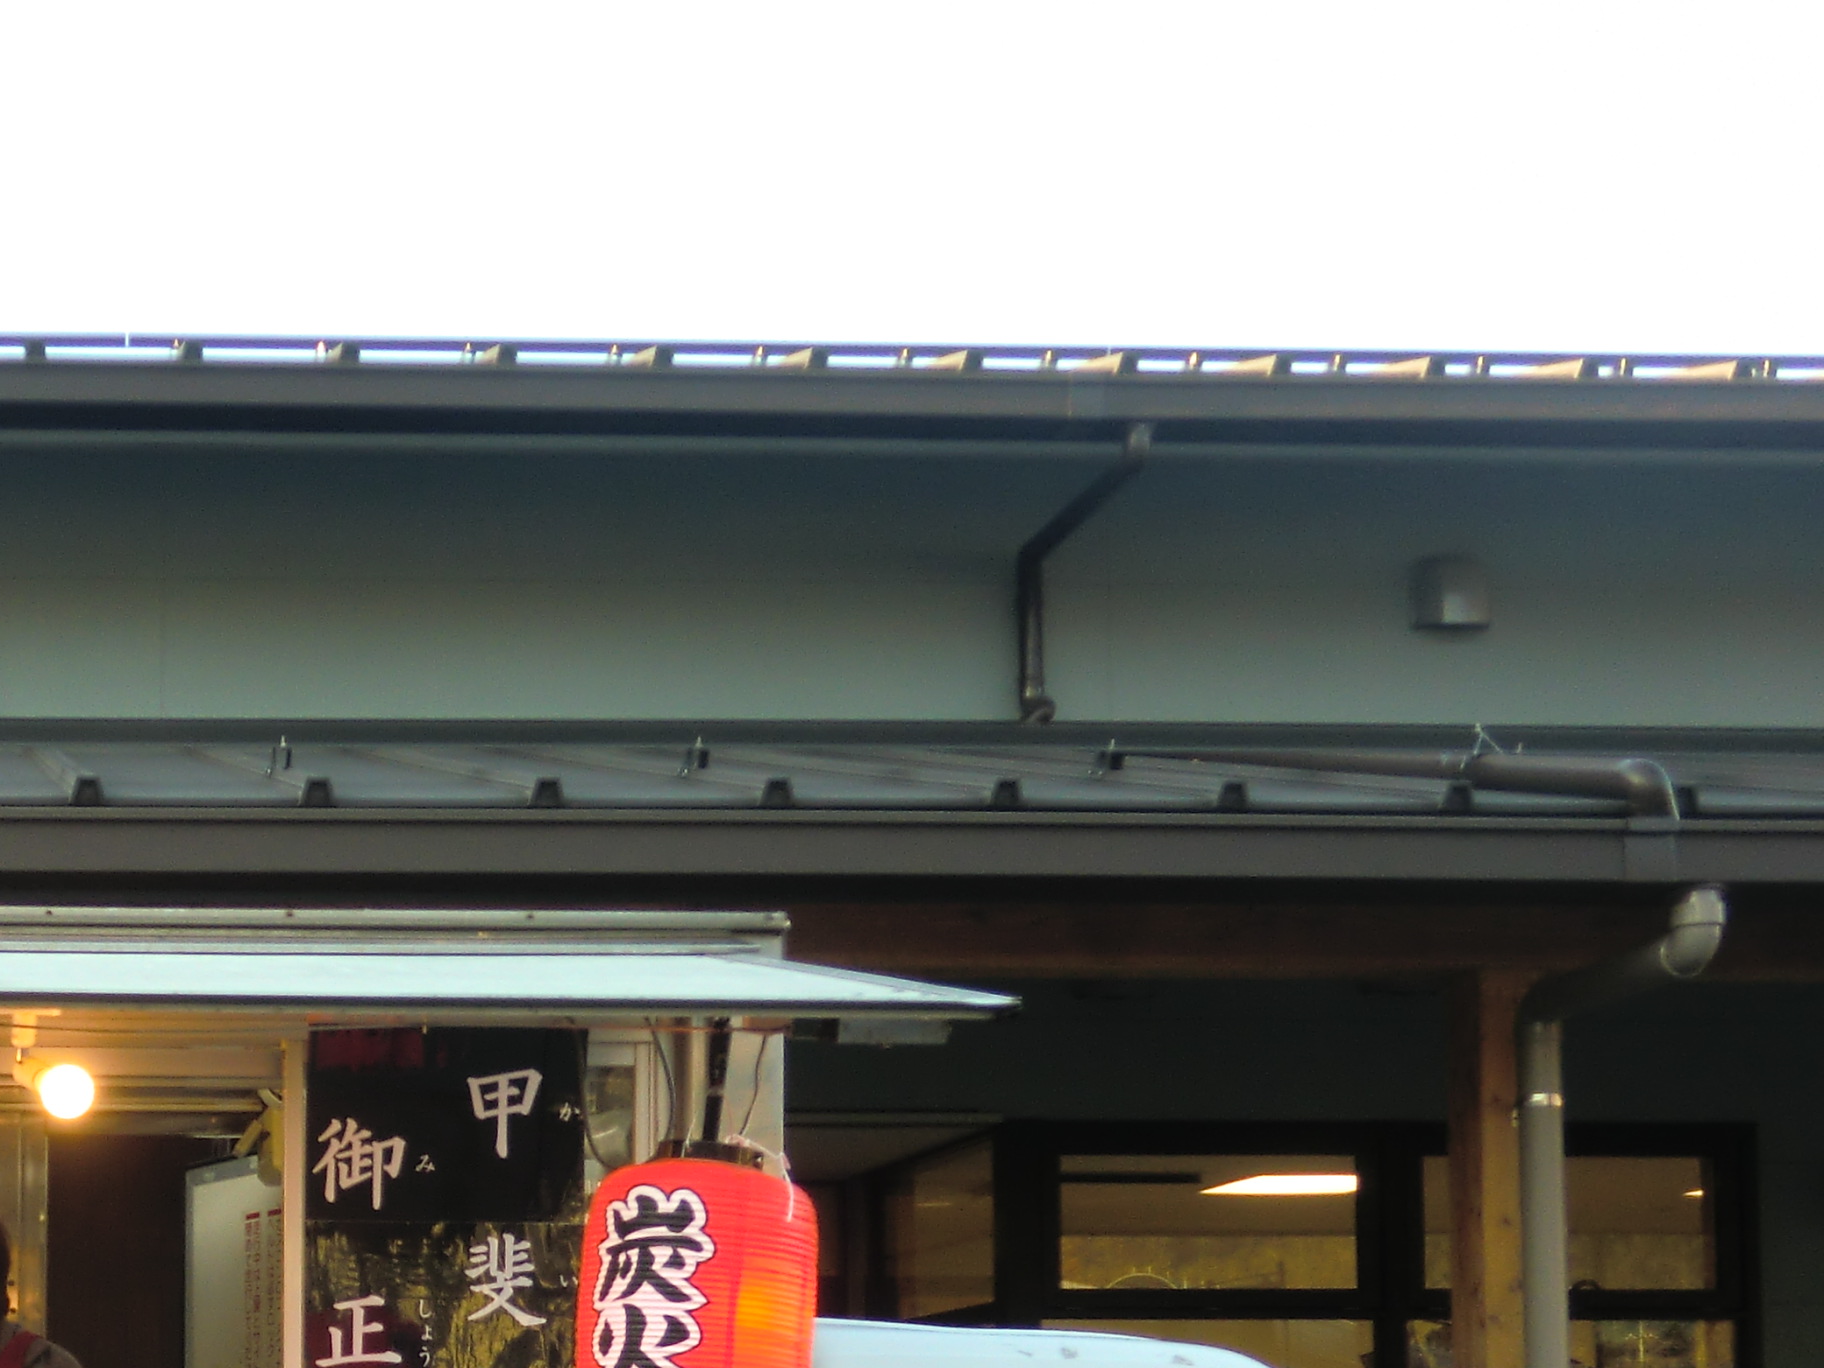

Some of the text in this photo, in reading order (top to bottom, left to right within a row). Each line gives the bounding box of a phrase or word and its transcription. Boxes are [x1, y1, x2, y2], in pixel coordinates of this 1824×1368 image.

[311, 1116, 406, 1368] 御正
[415, 1153, 436, 1174] み
[466, 1066, 547, 1327] 甲斐
